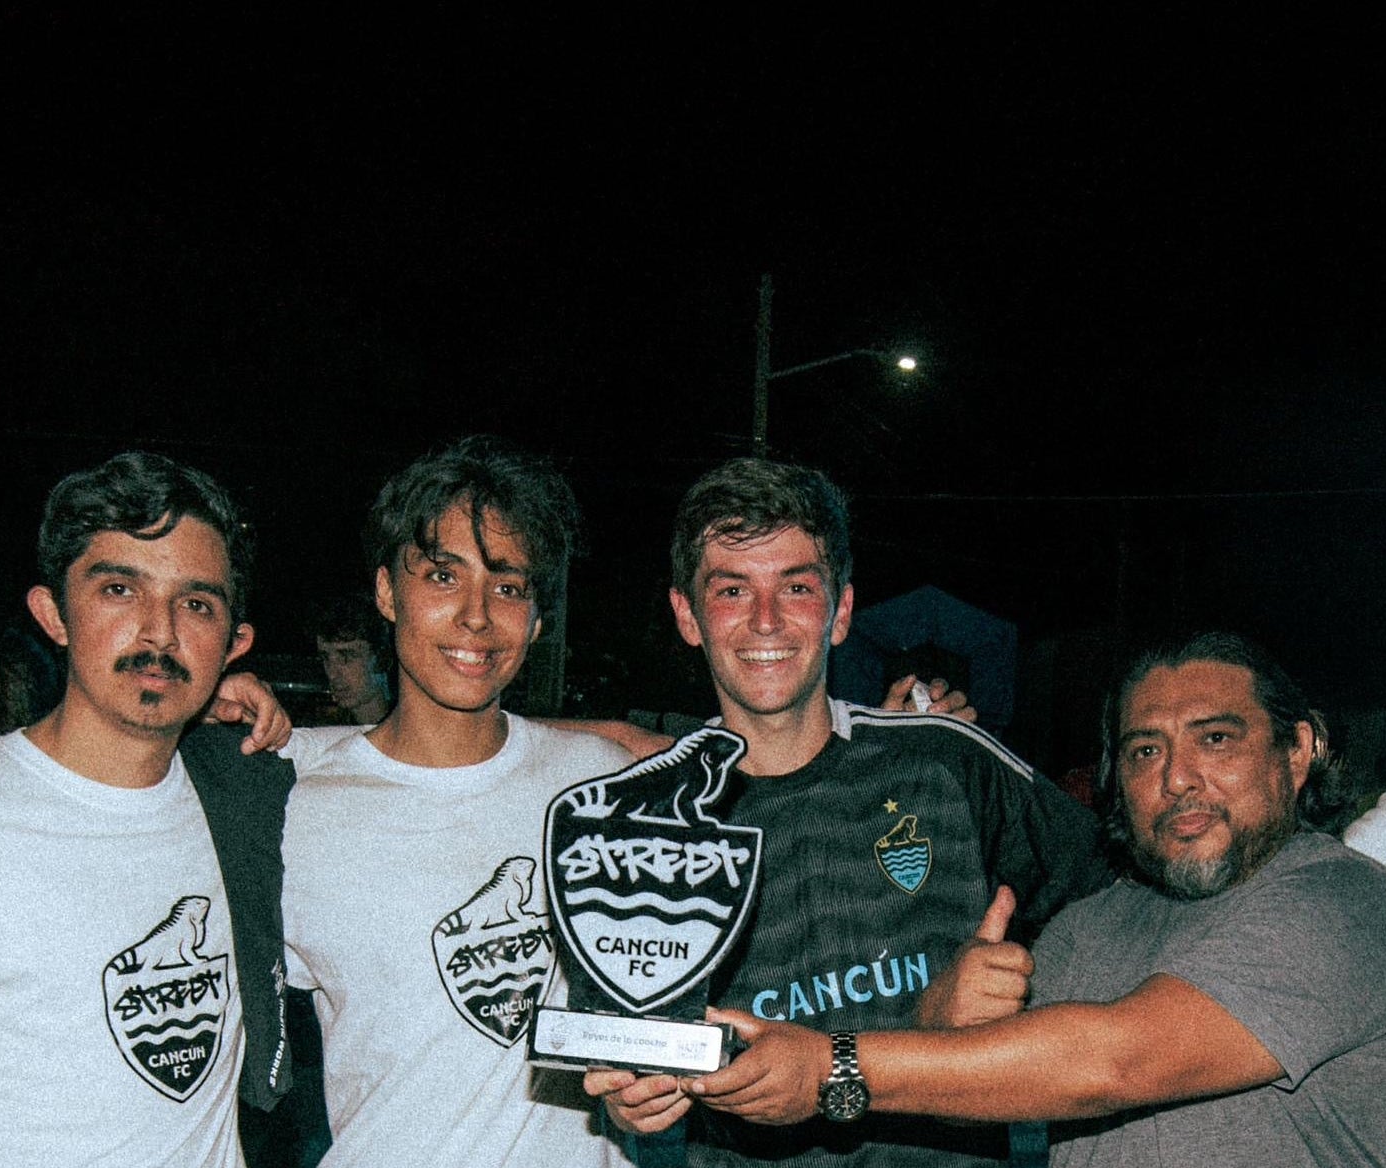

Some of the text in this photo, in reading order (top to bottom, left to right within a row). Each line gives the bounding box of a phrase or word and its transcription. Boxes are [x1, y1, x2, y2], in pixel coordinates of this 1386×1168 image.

[558, 834, 750, 888] STREET
[446, 925, 555, 978] STREET
[628, 960, 656, 977] FC
[114, 969, 222, 1021] STREET
[752, 949, 929, 1021] CANCÚN
[173, 1064, 191, 1079] FC
